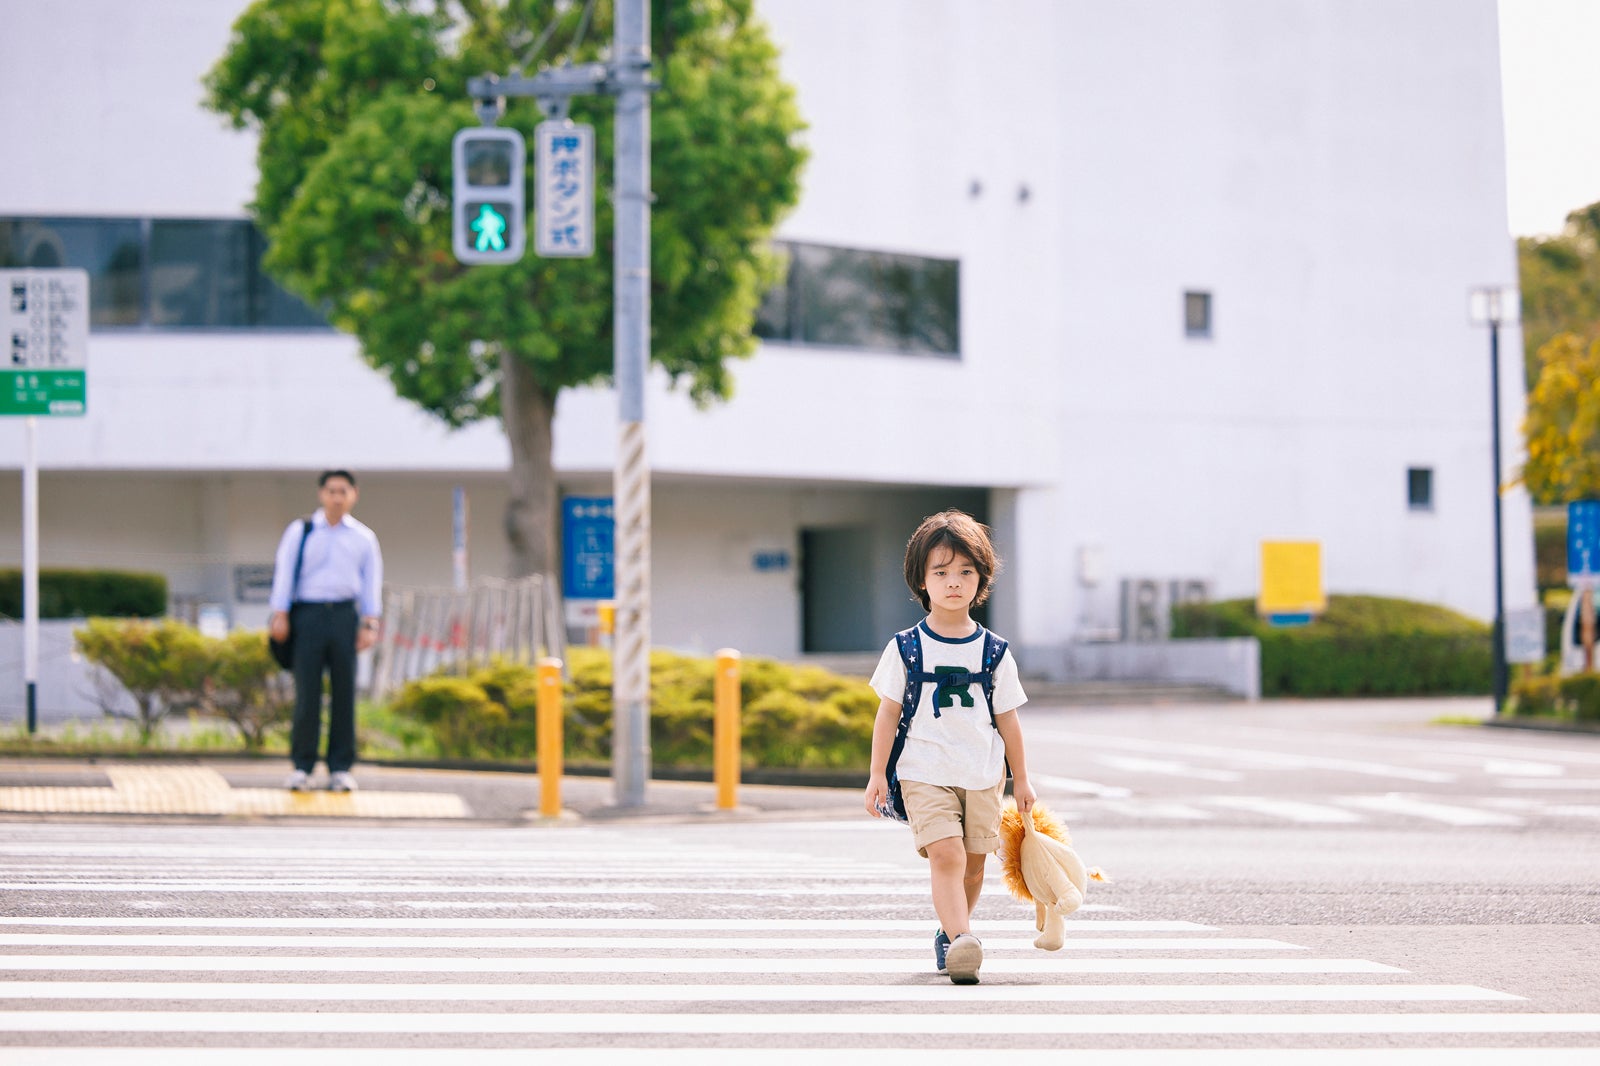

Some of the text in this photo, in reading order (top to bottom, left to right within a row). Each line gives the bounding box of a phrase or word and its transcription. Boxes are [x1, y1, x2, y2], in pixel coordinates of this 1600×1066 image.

[551, 135, 580, 246] 押ボタン式
[934, 665, 974, 708] R
